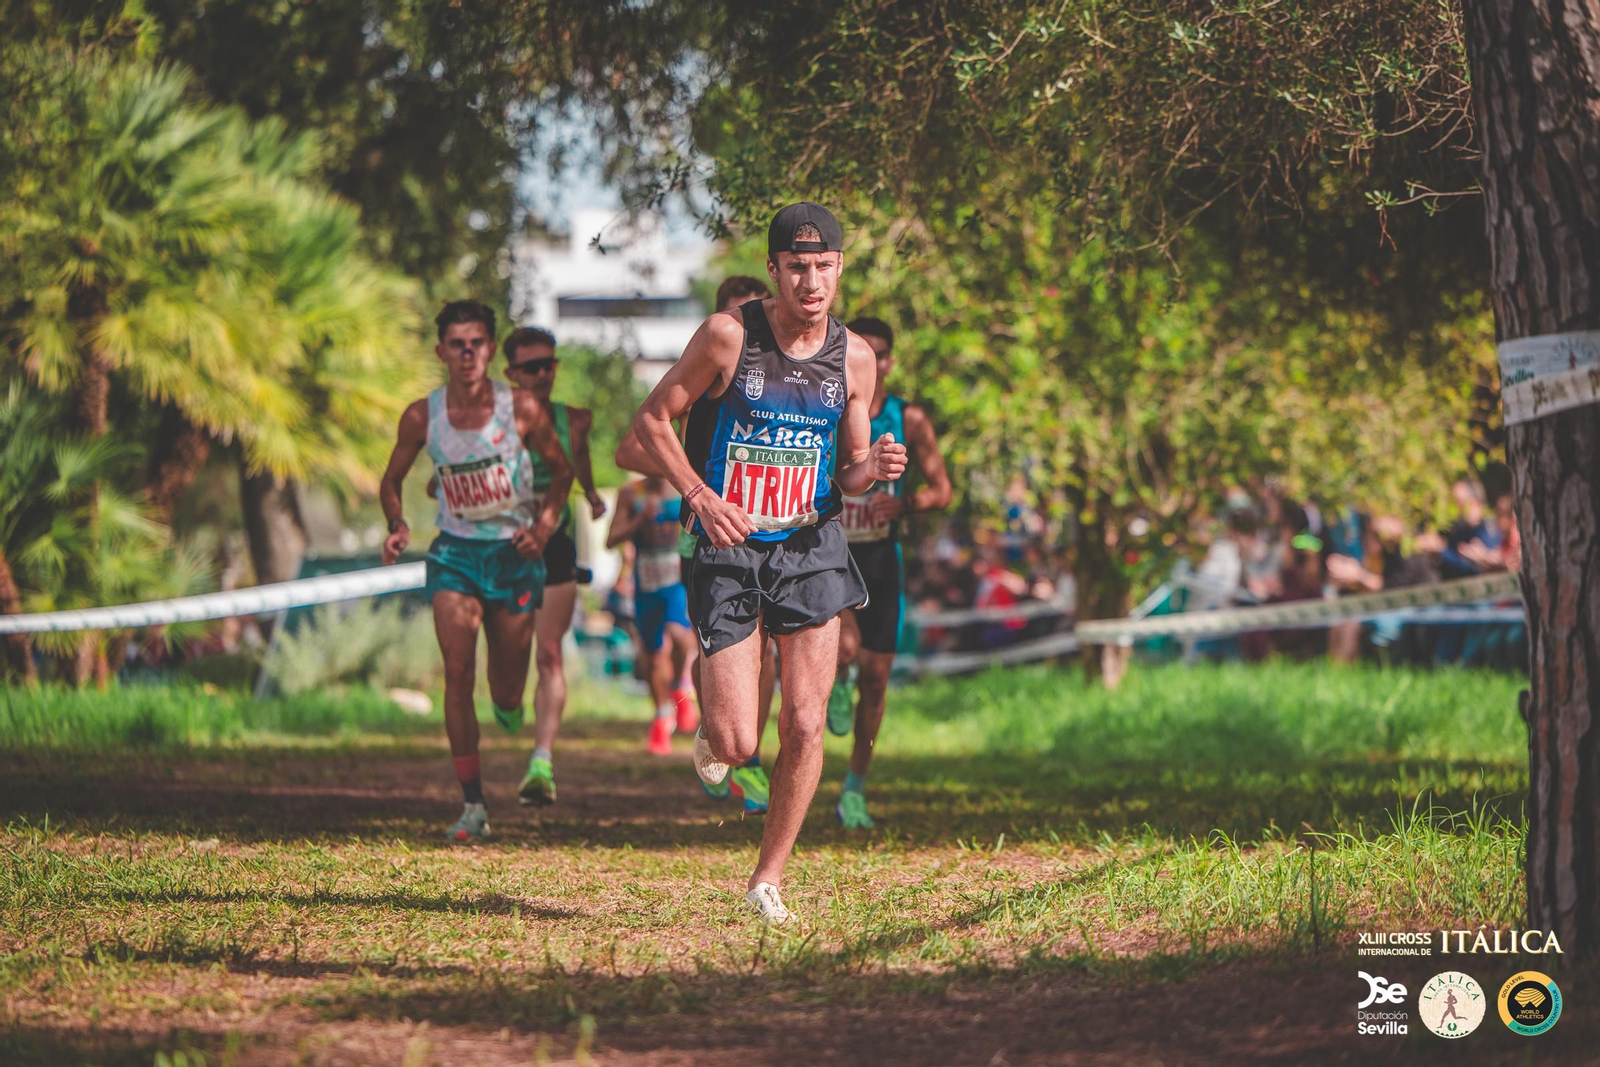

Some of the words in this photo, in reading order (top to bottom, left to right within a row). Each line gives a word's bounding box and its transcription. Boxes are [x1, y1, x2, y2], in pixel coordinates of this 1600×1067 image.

[784, 376, 808, 385] amura
[750, 409, 775, 420] CLUB
[777, 412, 828, 426] ATLETISMO
[754, 451, 798, 463] ITÁLICA
[442, 466, 511, 510] NARANJO
[726, 462, 815, 518] ATRIKI
